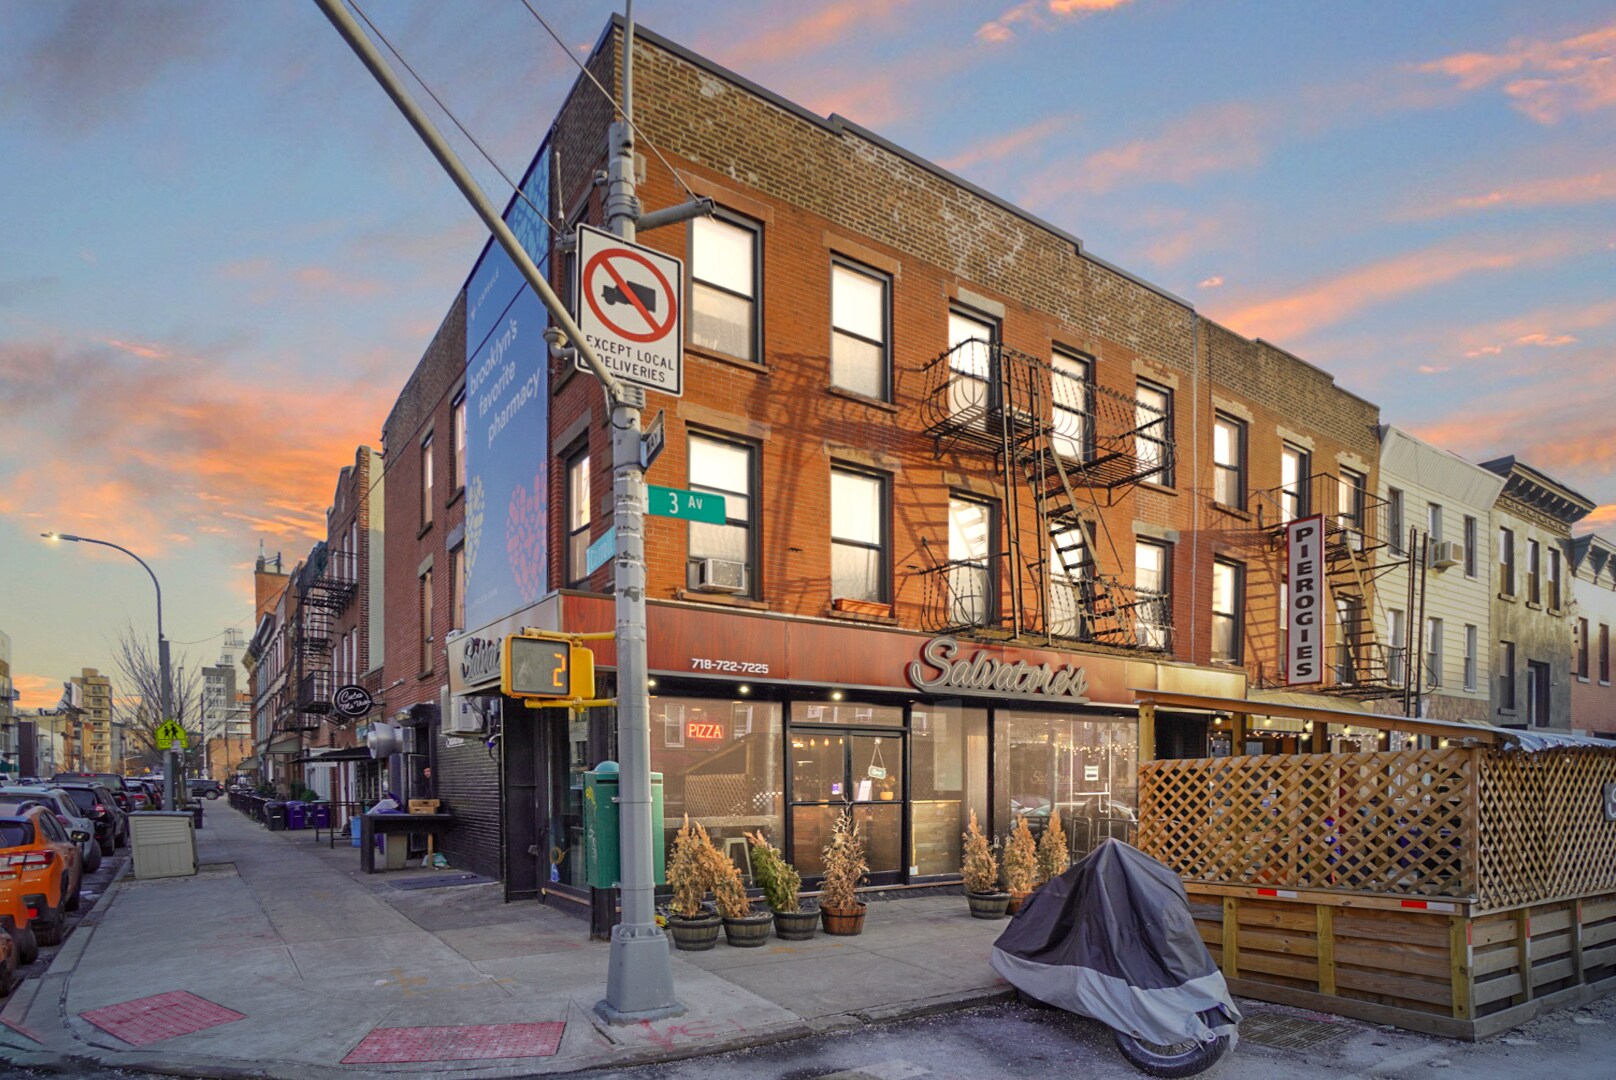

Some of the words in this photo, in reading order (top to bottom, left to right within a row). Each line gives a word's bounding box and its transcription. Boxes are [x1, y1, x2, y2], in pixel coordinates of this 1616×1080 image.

[469, 318, 518, 397] brooklyn's
[586, 334, 633, 358] EXCEPT
[637, 350, 675, 371] LOCAL
[478, 359, 517, 417] favorite
[487, 367, 541, 449] pharmacy
[668, 492, 679, 515] 3
[1295, 526, 1315, 678] PIEROGIES
[552, 653, 567, 689] 2
[691, 658, 769, 674] 718-722-7225
[908, 636, 1089, 698] Salvatore's
[341, 690, 364, 703] Cuba
[688, 723, 722, 739] PIZZA
